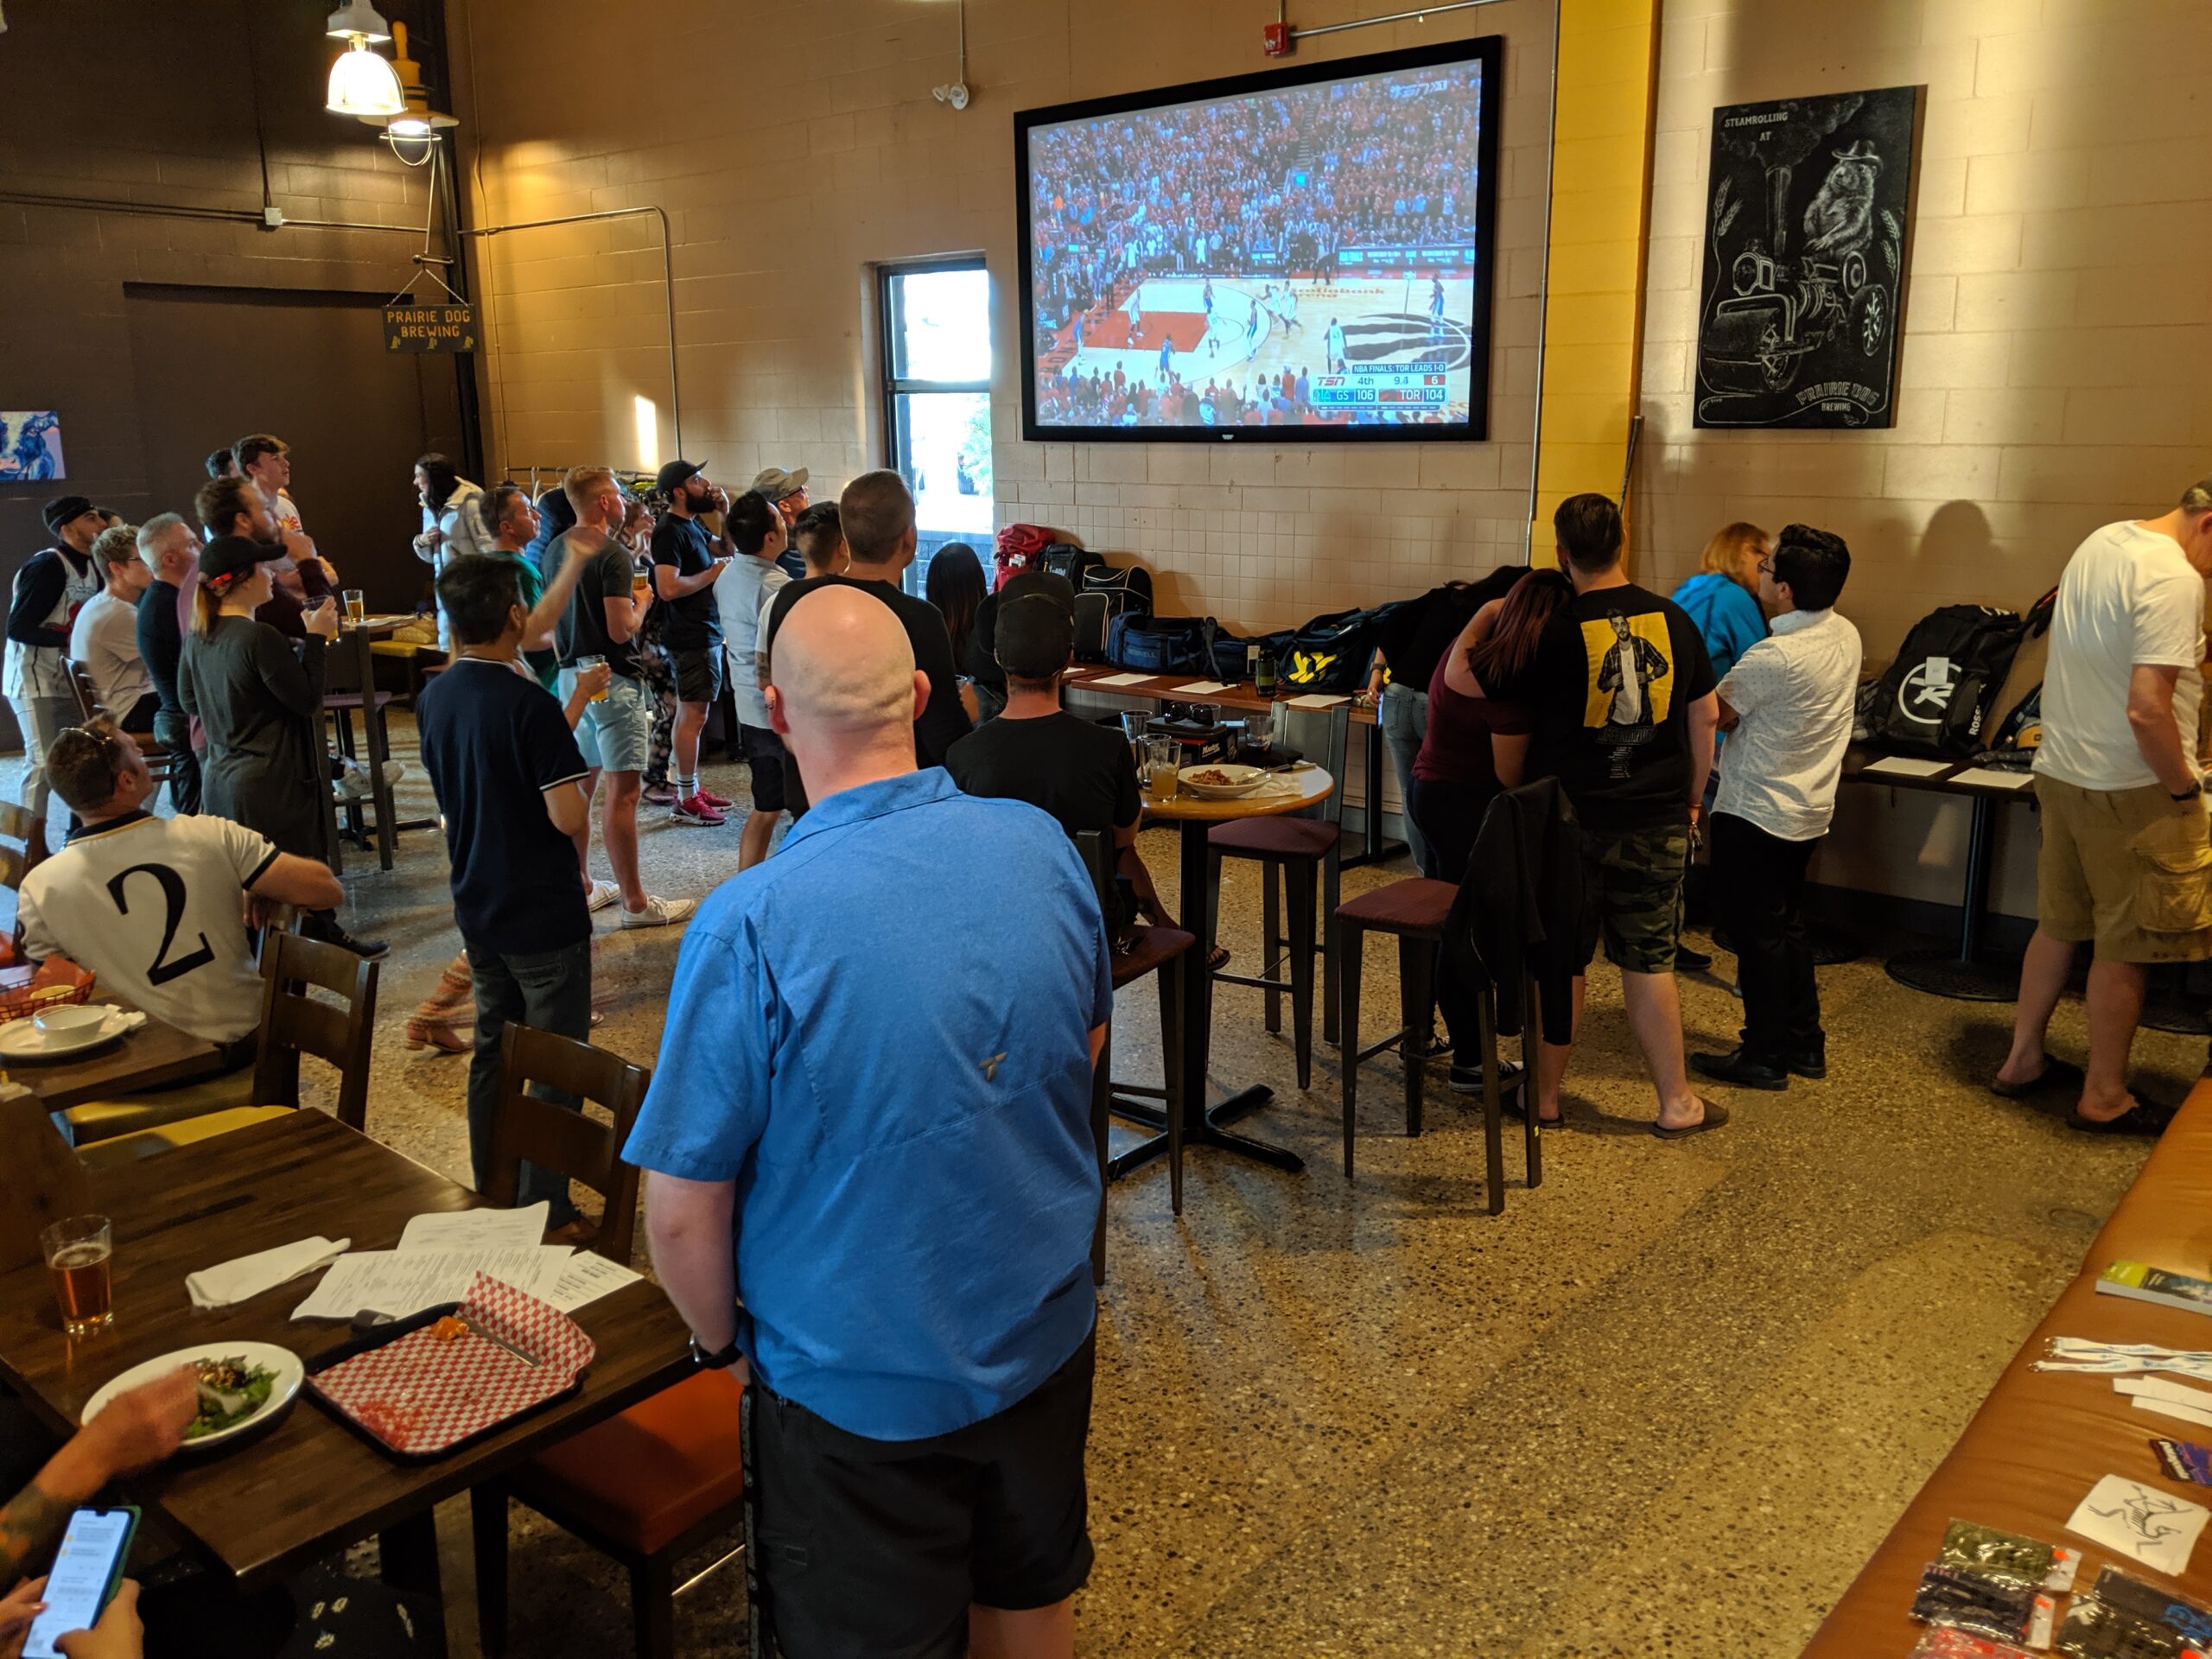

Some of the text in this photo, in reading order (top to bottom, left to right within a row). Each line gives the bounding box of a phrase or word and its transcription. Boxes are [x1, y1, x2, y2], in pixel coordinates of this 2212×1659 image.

[1725, 111, 1788, 128] STEAMROLLING
[1759, 131, 1772, 142] AT
[387, 309, 471, 323] PRAIRIE DOG
[401, 326, 461, 338] BREWING
[1318, 377, 1345, 386] TSN
[1357, 377, 1374, 385] 4th
[1431, 376, 1439, 385] 6
[1337, 390, 1443, 401] GS 106 TOR 104
[1796, 381, 1880, 406] PRAIRIE DOG
[1821, 403, 1852, 412] BREWING
[106, 862, 215, 987] 2
